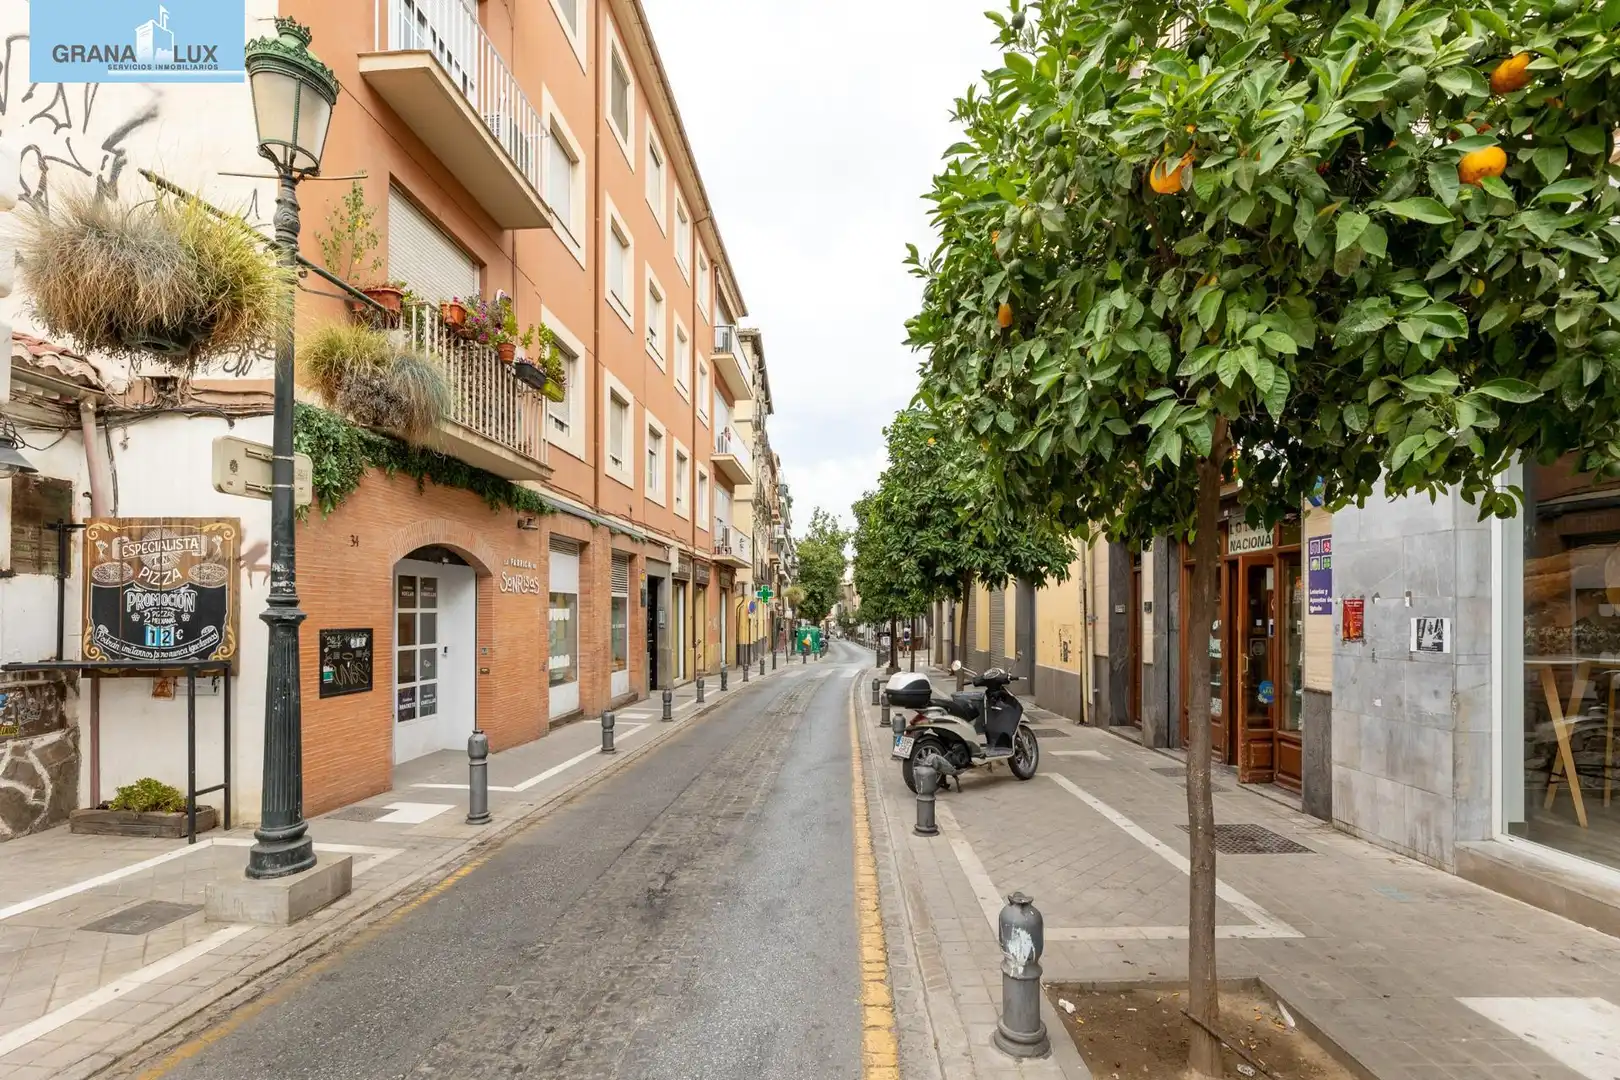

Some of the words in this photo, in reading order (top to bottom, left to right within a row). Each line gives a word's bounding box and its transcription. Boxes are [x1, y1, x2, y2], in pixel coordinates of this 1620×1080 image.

[122, 537, 199, 557] ESPECIALISTA
[350, 534, 359, 547] 34
[1230, 535, 1271, 552] NACIONA
[138, 566, 183, 585] PIZZA
[144, 612, 151, 623] 2
